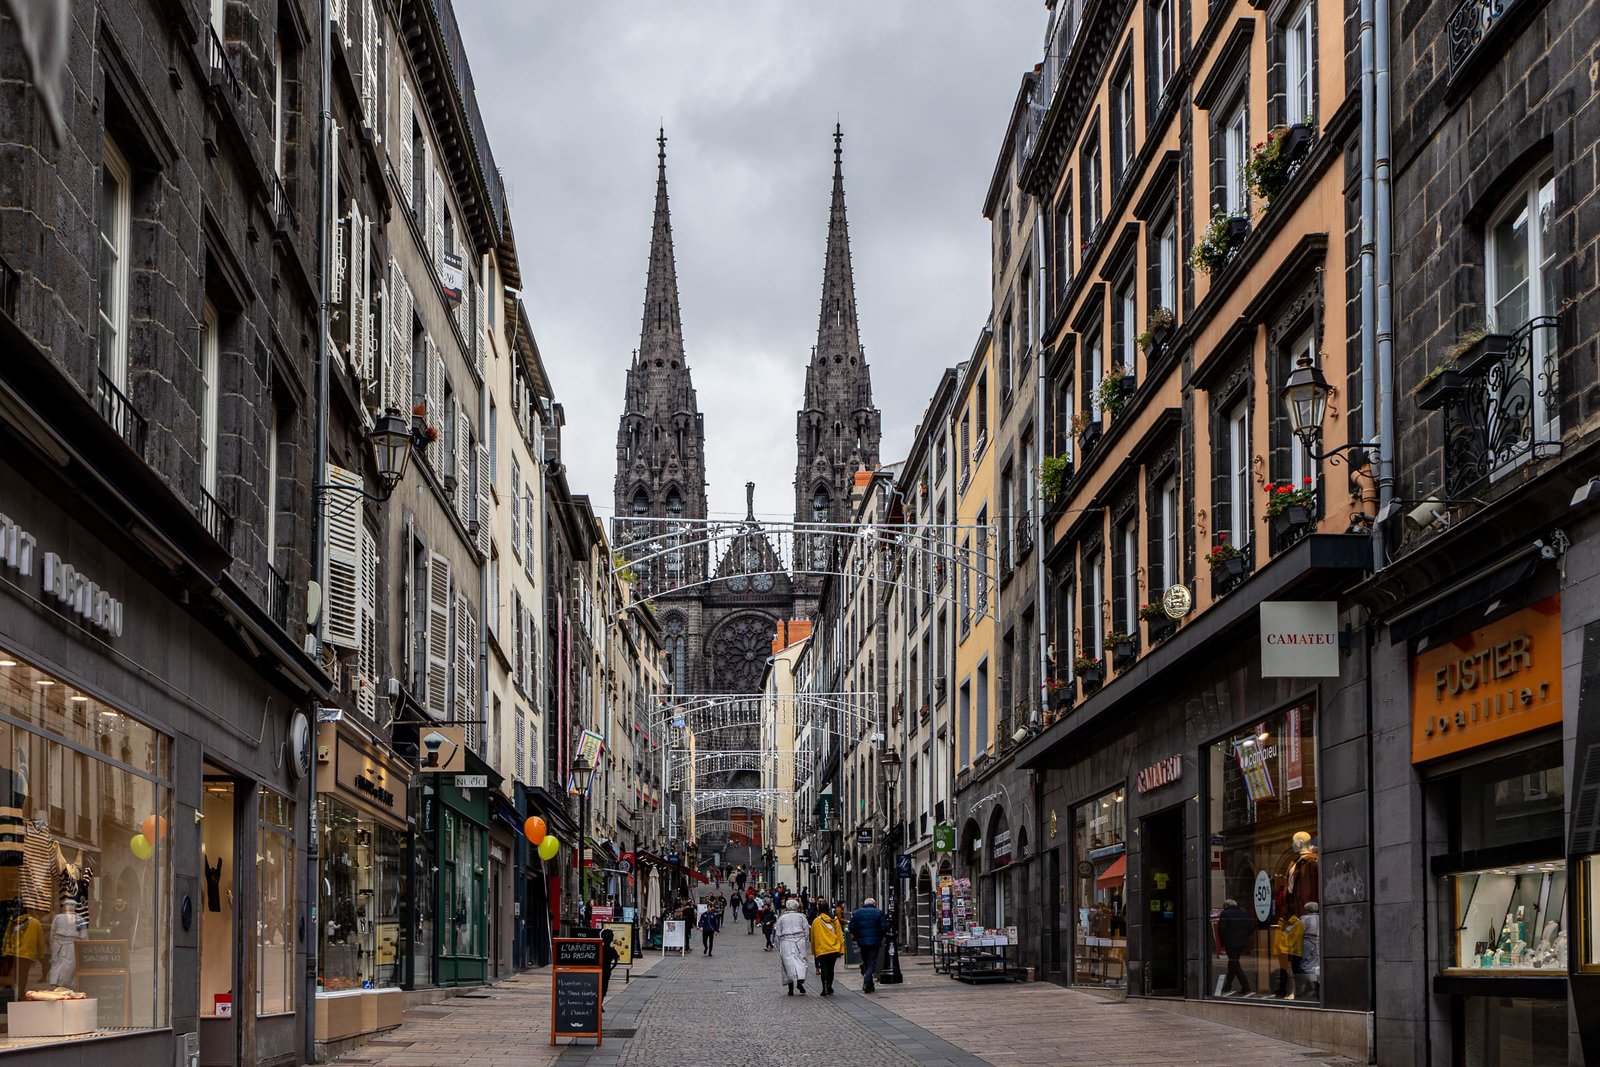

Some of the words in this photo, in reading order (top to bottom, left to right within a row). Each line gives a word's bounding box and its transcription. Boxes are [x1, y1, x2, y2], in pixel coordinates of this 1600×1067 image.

[44, 552, 123, 638] BATEAU
[1435, 634, 1532, 702] FUSTIER
[560, 952, 571, 960] DU
[561, 942, 597, 952] L'UNIVERS
